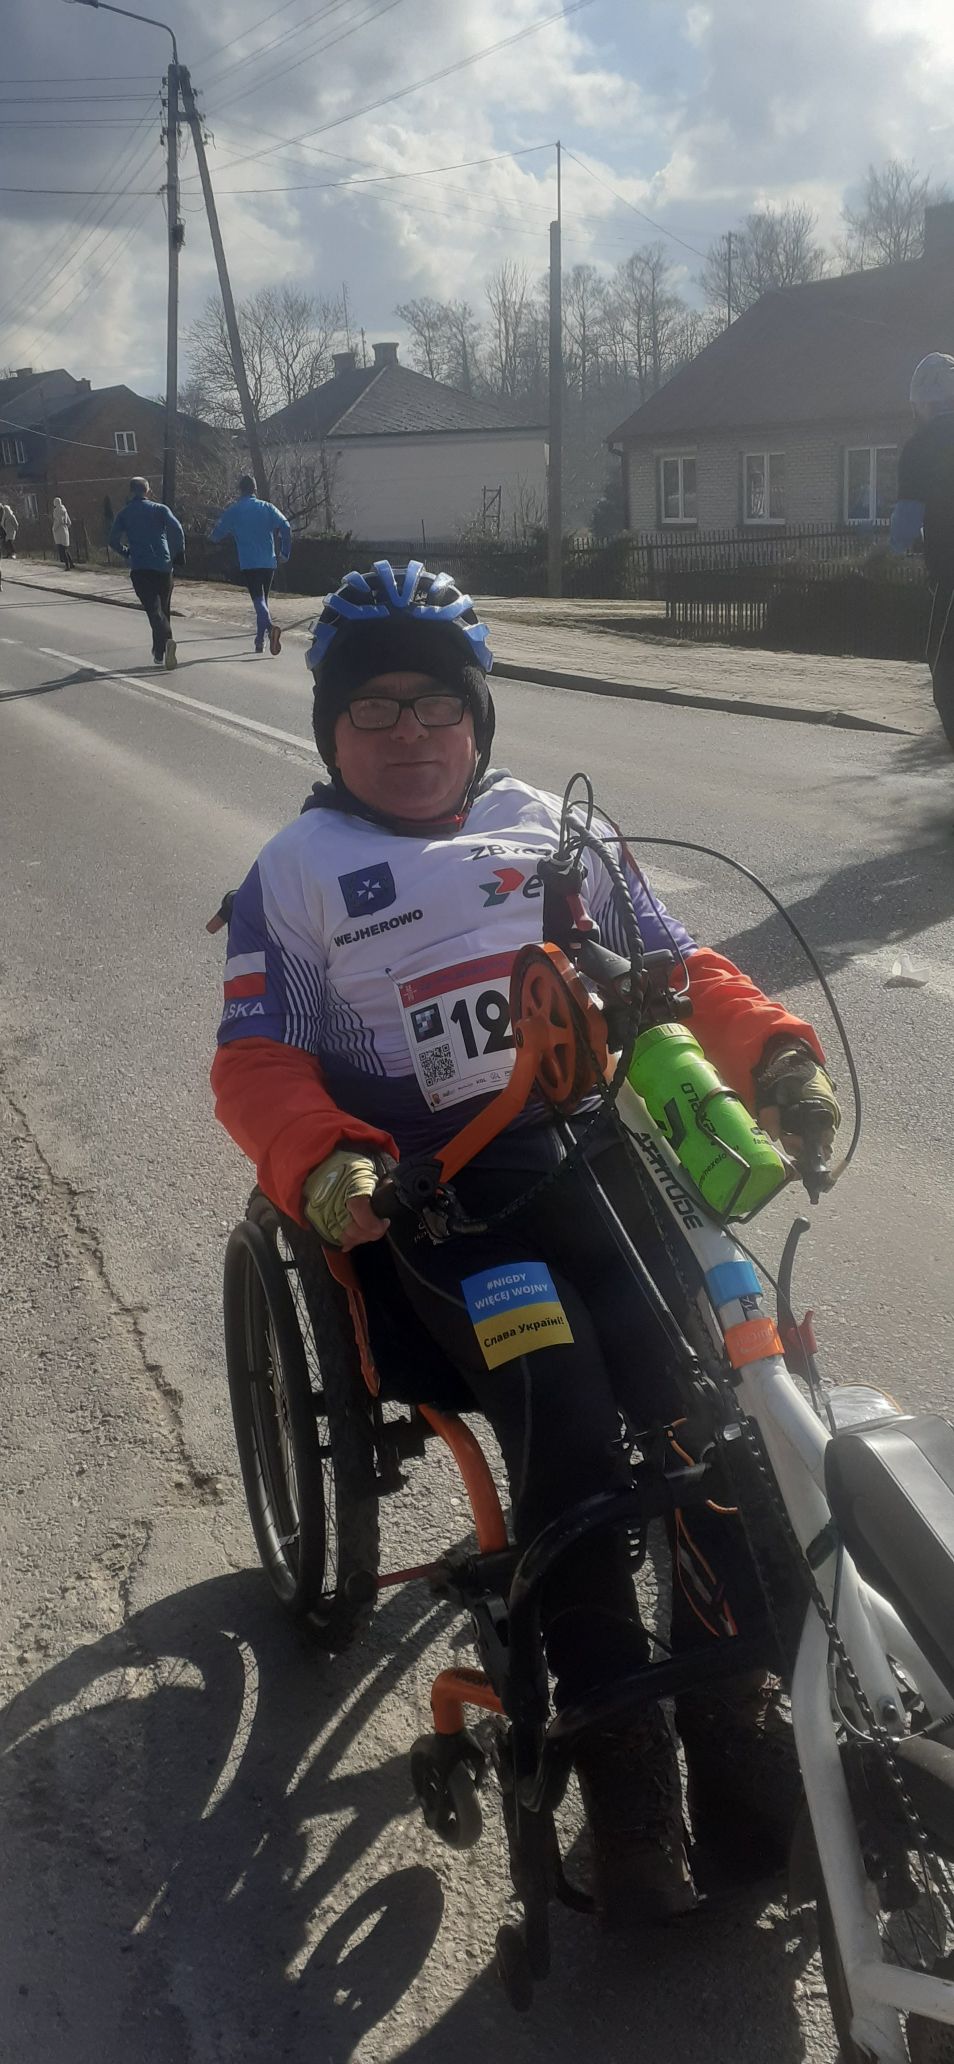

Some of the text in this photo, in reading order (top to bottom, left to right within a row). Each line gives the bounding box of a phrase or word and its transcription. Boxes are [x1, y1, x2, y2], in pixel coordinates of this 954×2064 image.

[334, 909, 424, 947] WEJHEROWO
[634, 1132, 704, 1230] ATTITUDE
[474, 1283, 550, 1310] WIĘCEJ WOJNY
[486, 1273, 527, 1291] #NIGDY
[483, 1316, 565, 1348] Слава Україні!
